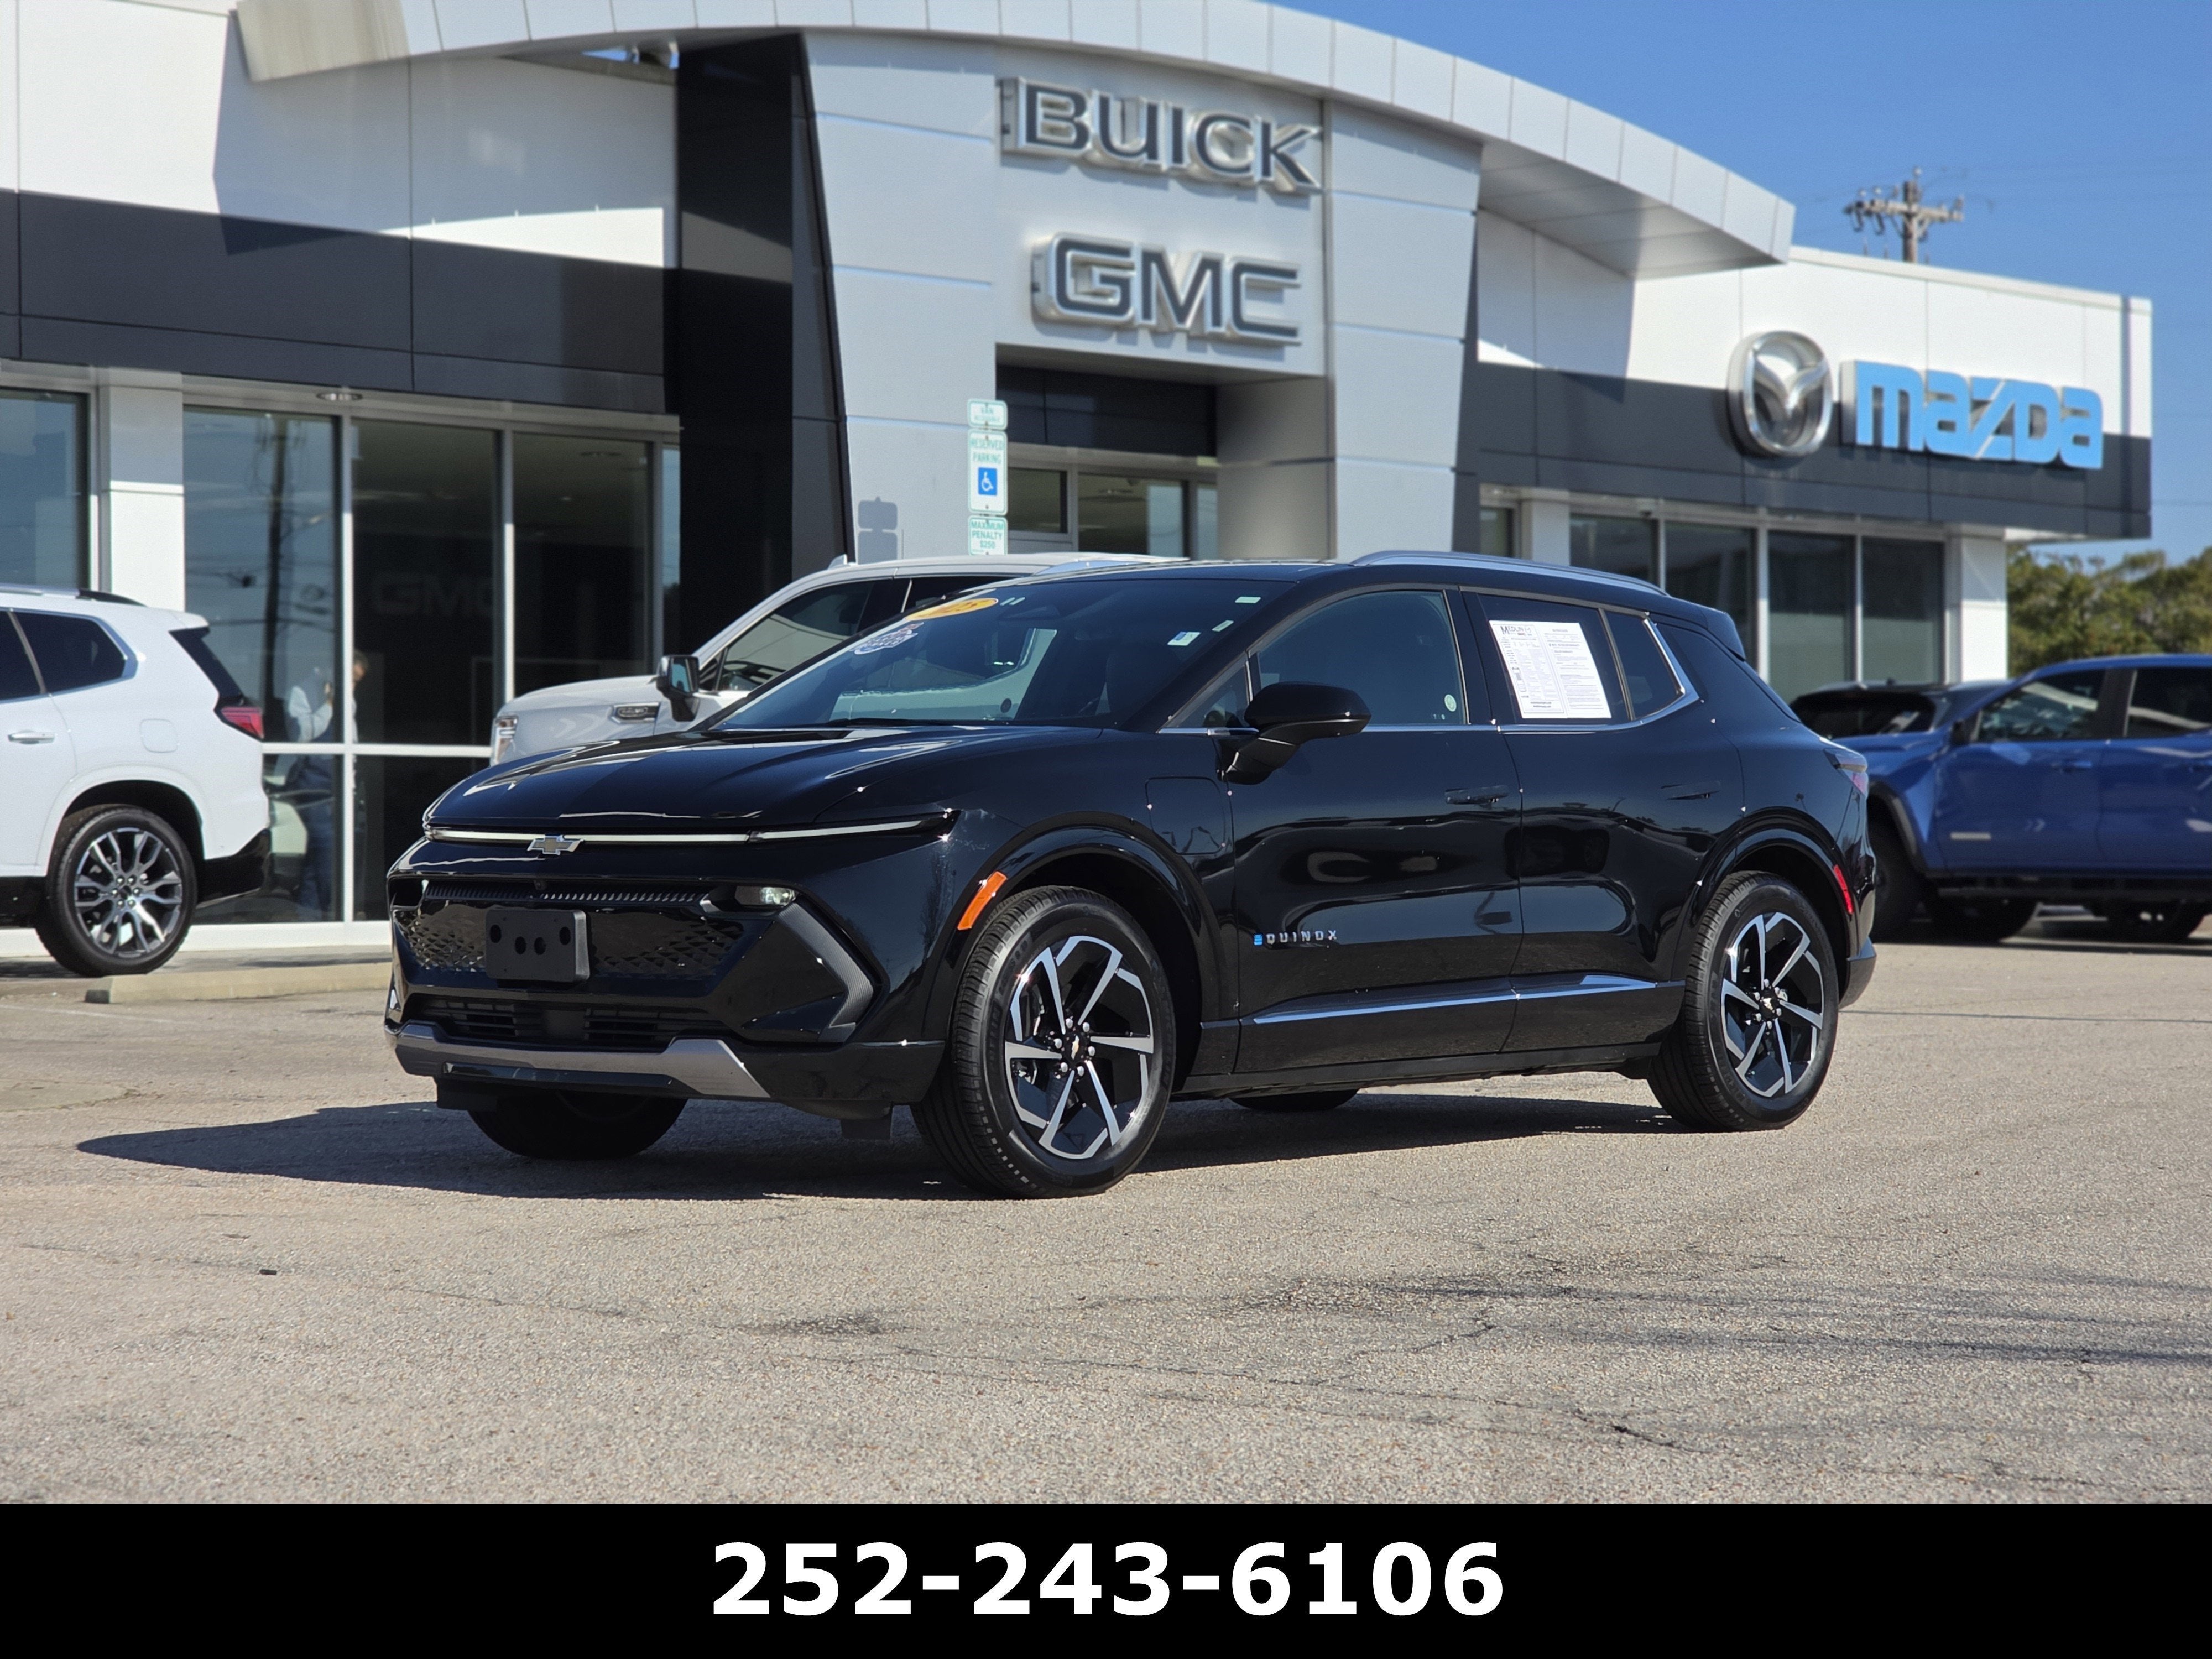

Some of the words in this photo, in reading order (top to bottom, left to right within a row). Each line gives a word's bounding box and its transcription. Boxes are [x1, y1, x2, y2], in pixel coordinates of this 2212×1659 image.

[1010, 77, 1324, 195] BUICK
[1044, 233, 1302, 346] GMC
[973, 452, 1001, 464] PARKING
[971, 521, 1004, 529] MAXIMUM
[972, 530, 1003, 540] PENALTY
[1254, 930, 1337, 945] EQUINOX
